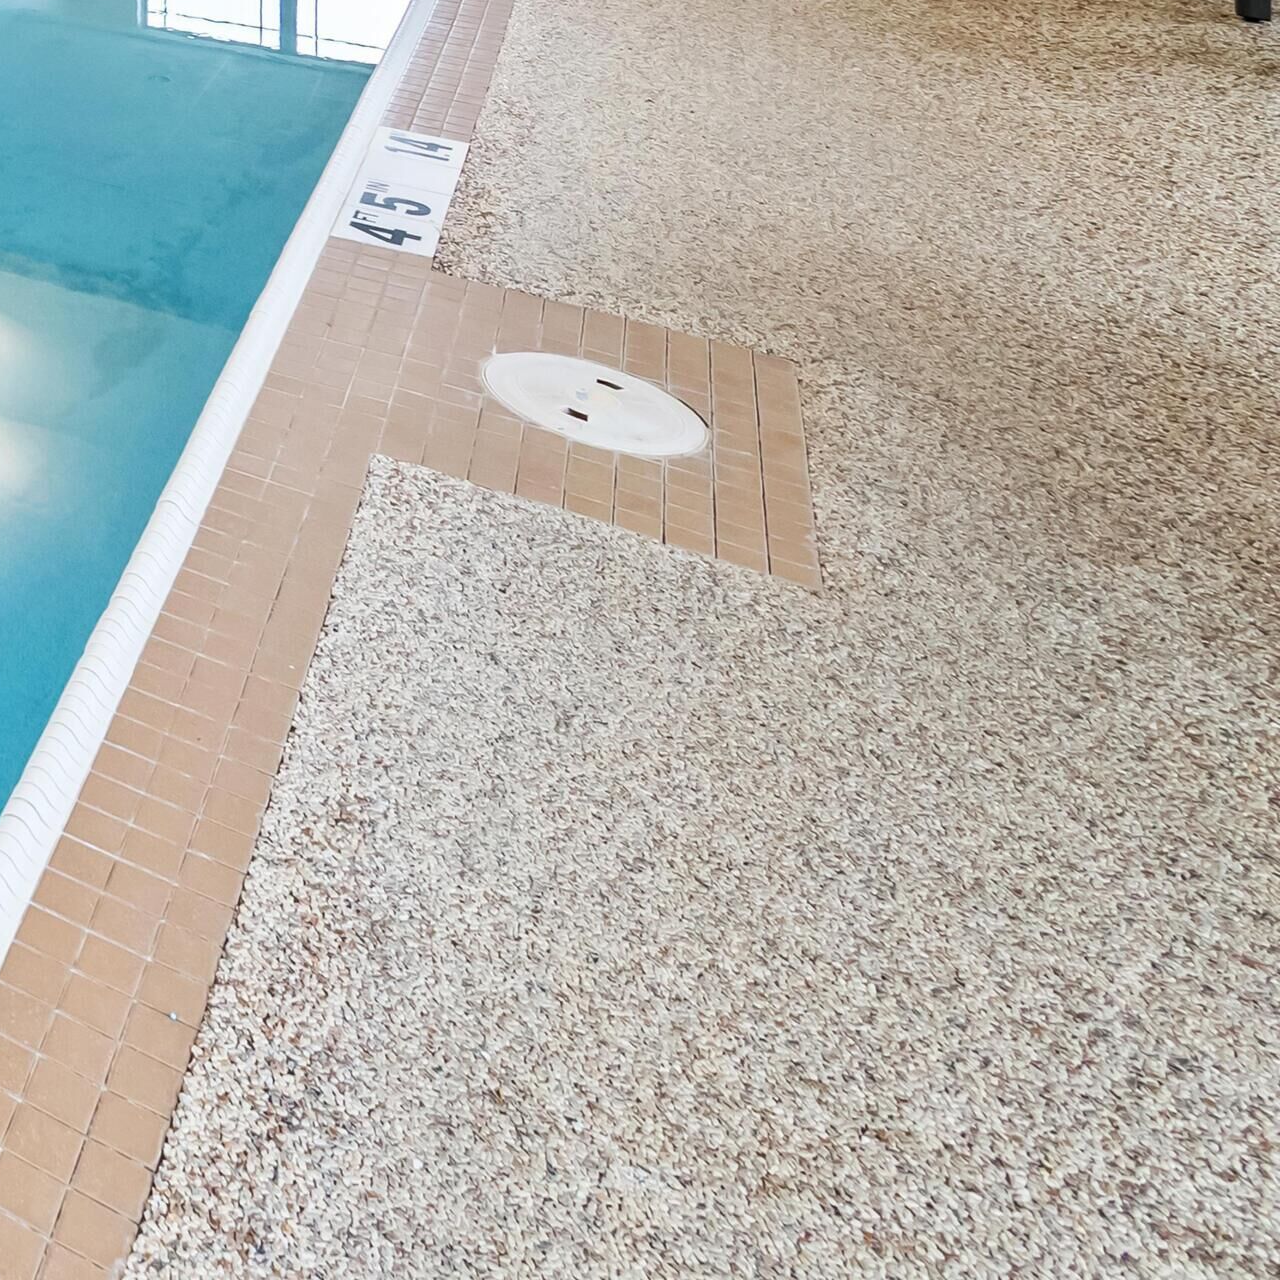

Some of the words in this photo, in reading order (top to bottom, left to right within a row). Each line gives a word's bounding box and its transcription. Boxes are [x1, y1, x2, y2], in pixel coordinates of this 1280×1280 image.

[352, 210, 379, 223] FT
[360, 191, 432, 217] 5
[349, 221, 422, 246] 4
